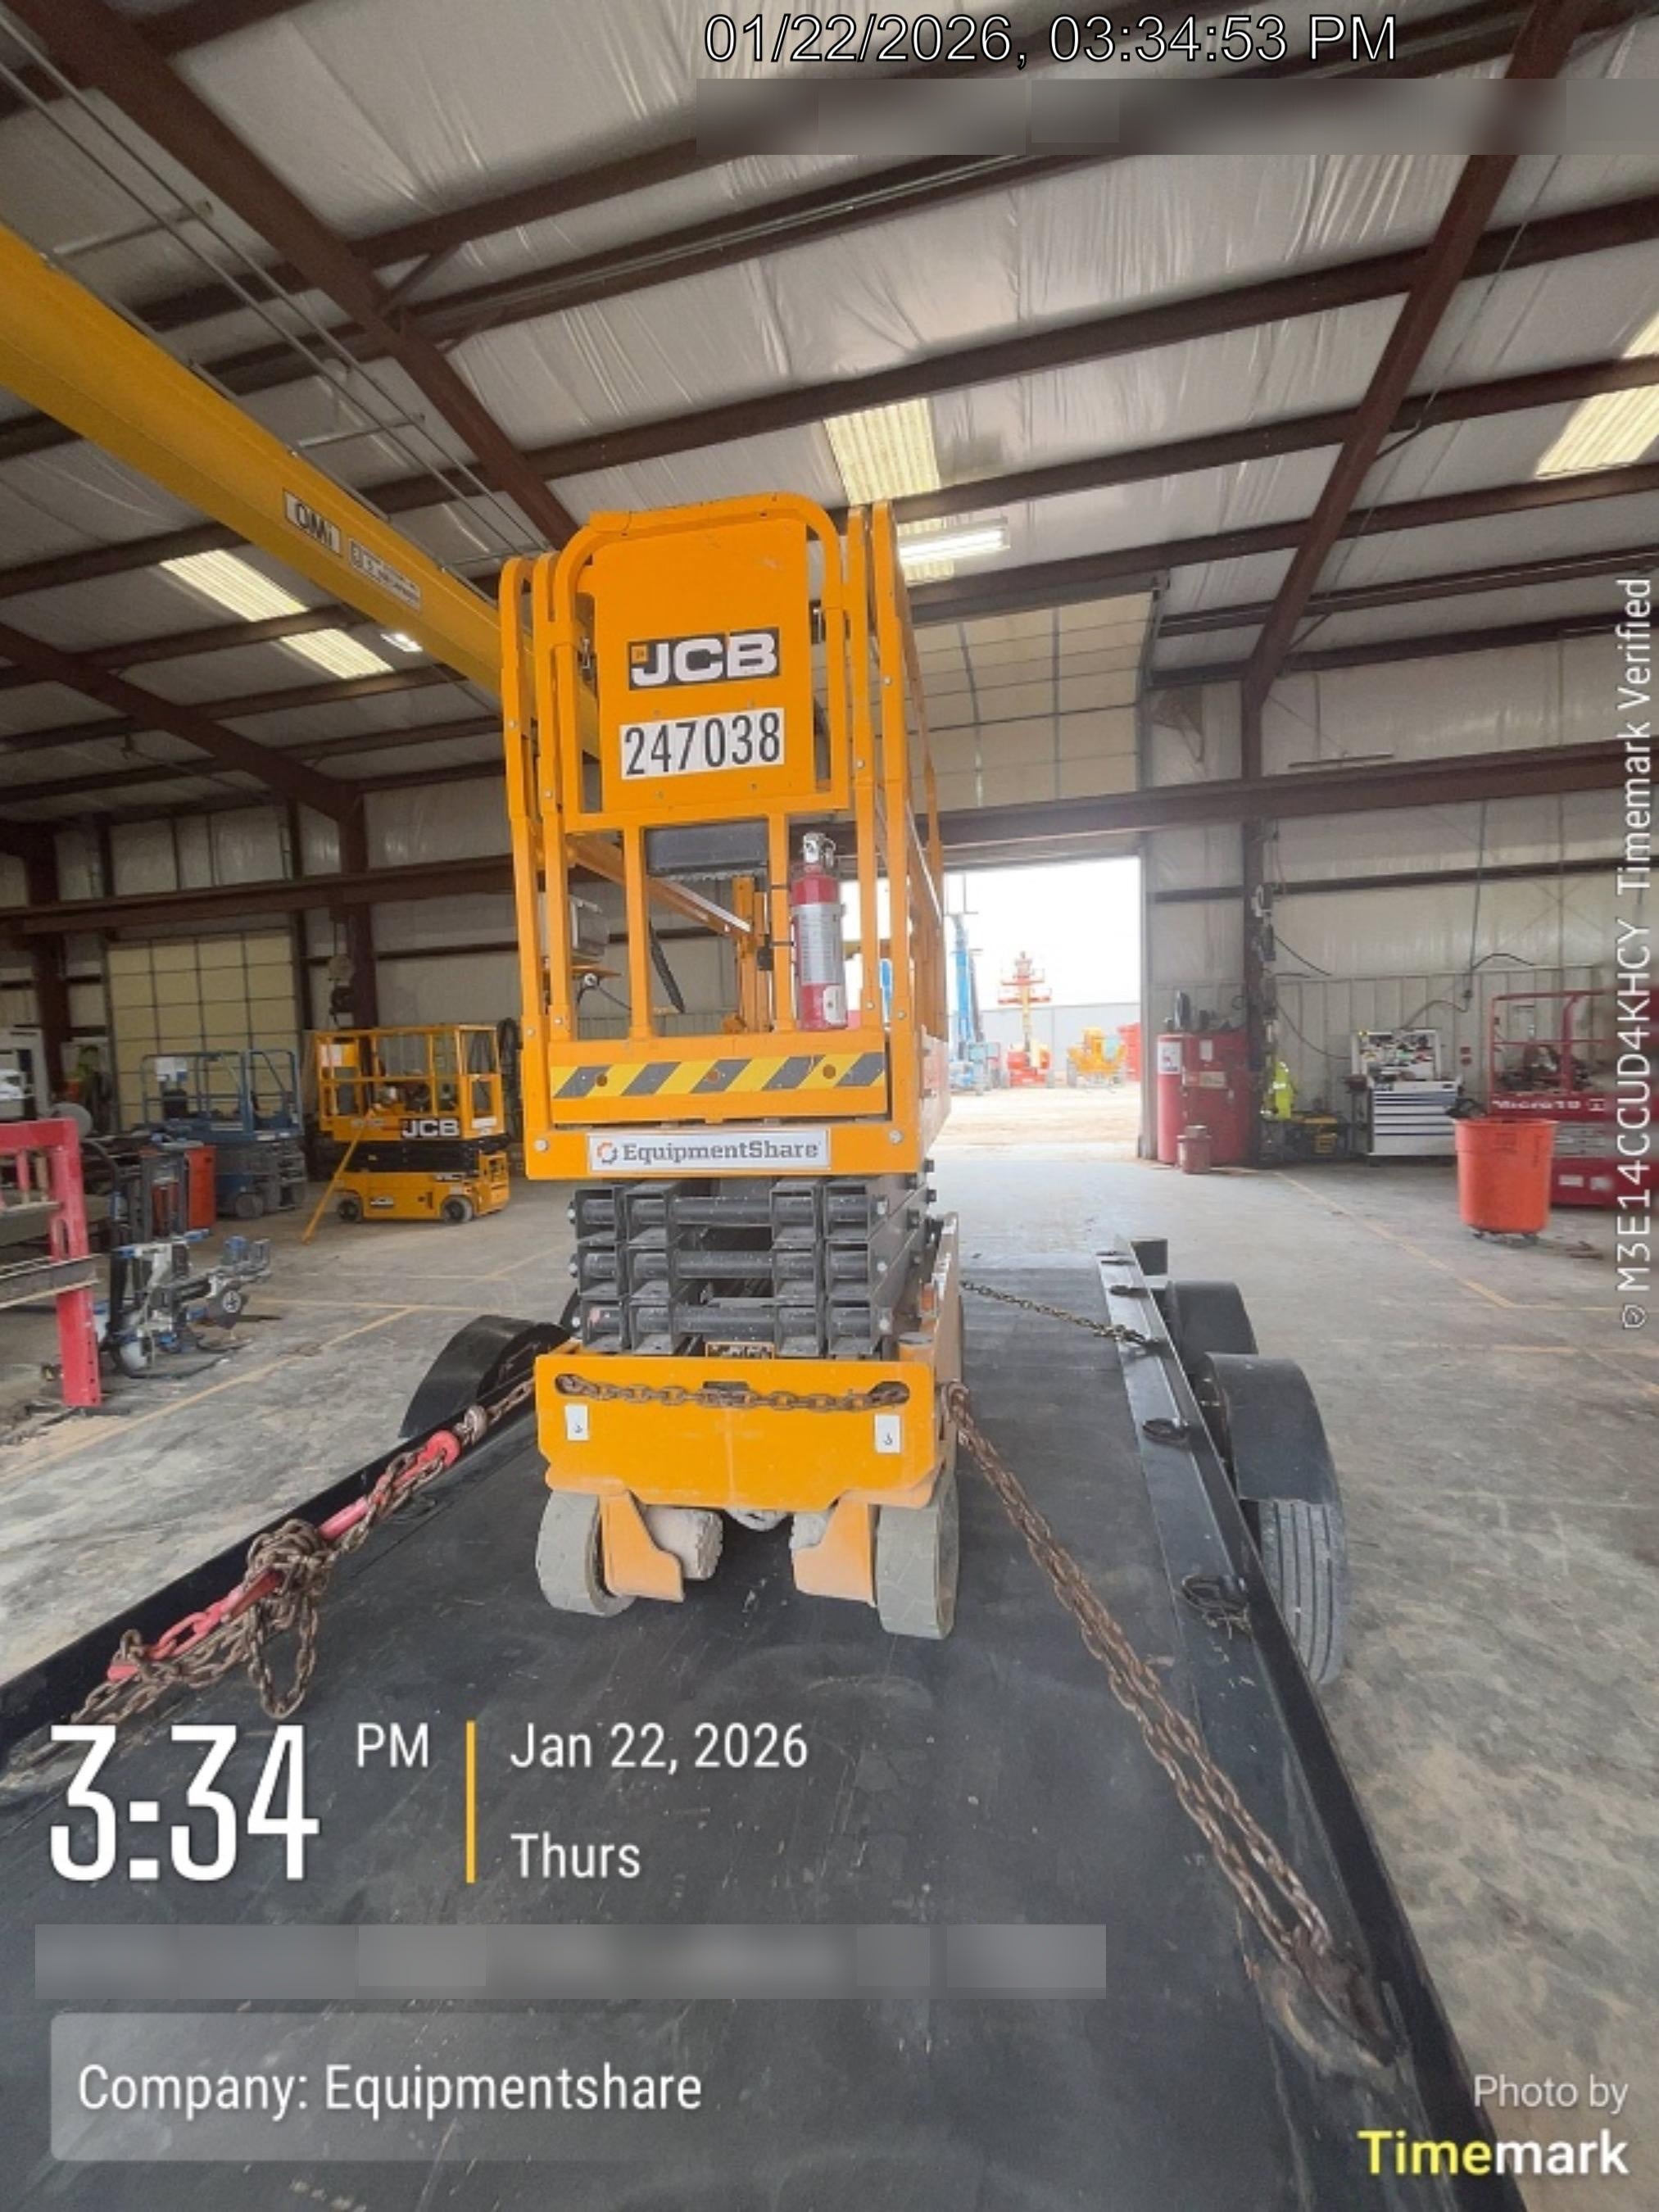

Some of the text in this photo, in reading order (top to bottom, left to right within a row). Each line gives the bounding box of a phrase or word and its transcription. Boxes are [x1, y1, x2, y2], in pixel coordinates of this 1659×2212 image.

[631, 633, 777, 687] JCB
[625, 712, 779, 775] 247038
[402, 1120, 460, 1136] JCB
[623, 1140, 818, 1164] EquipmentShare
